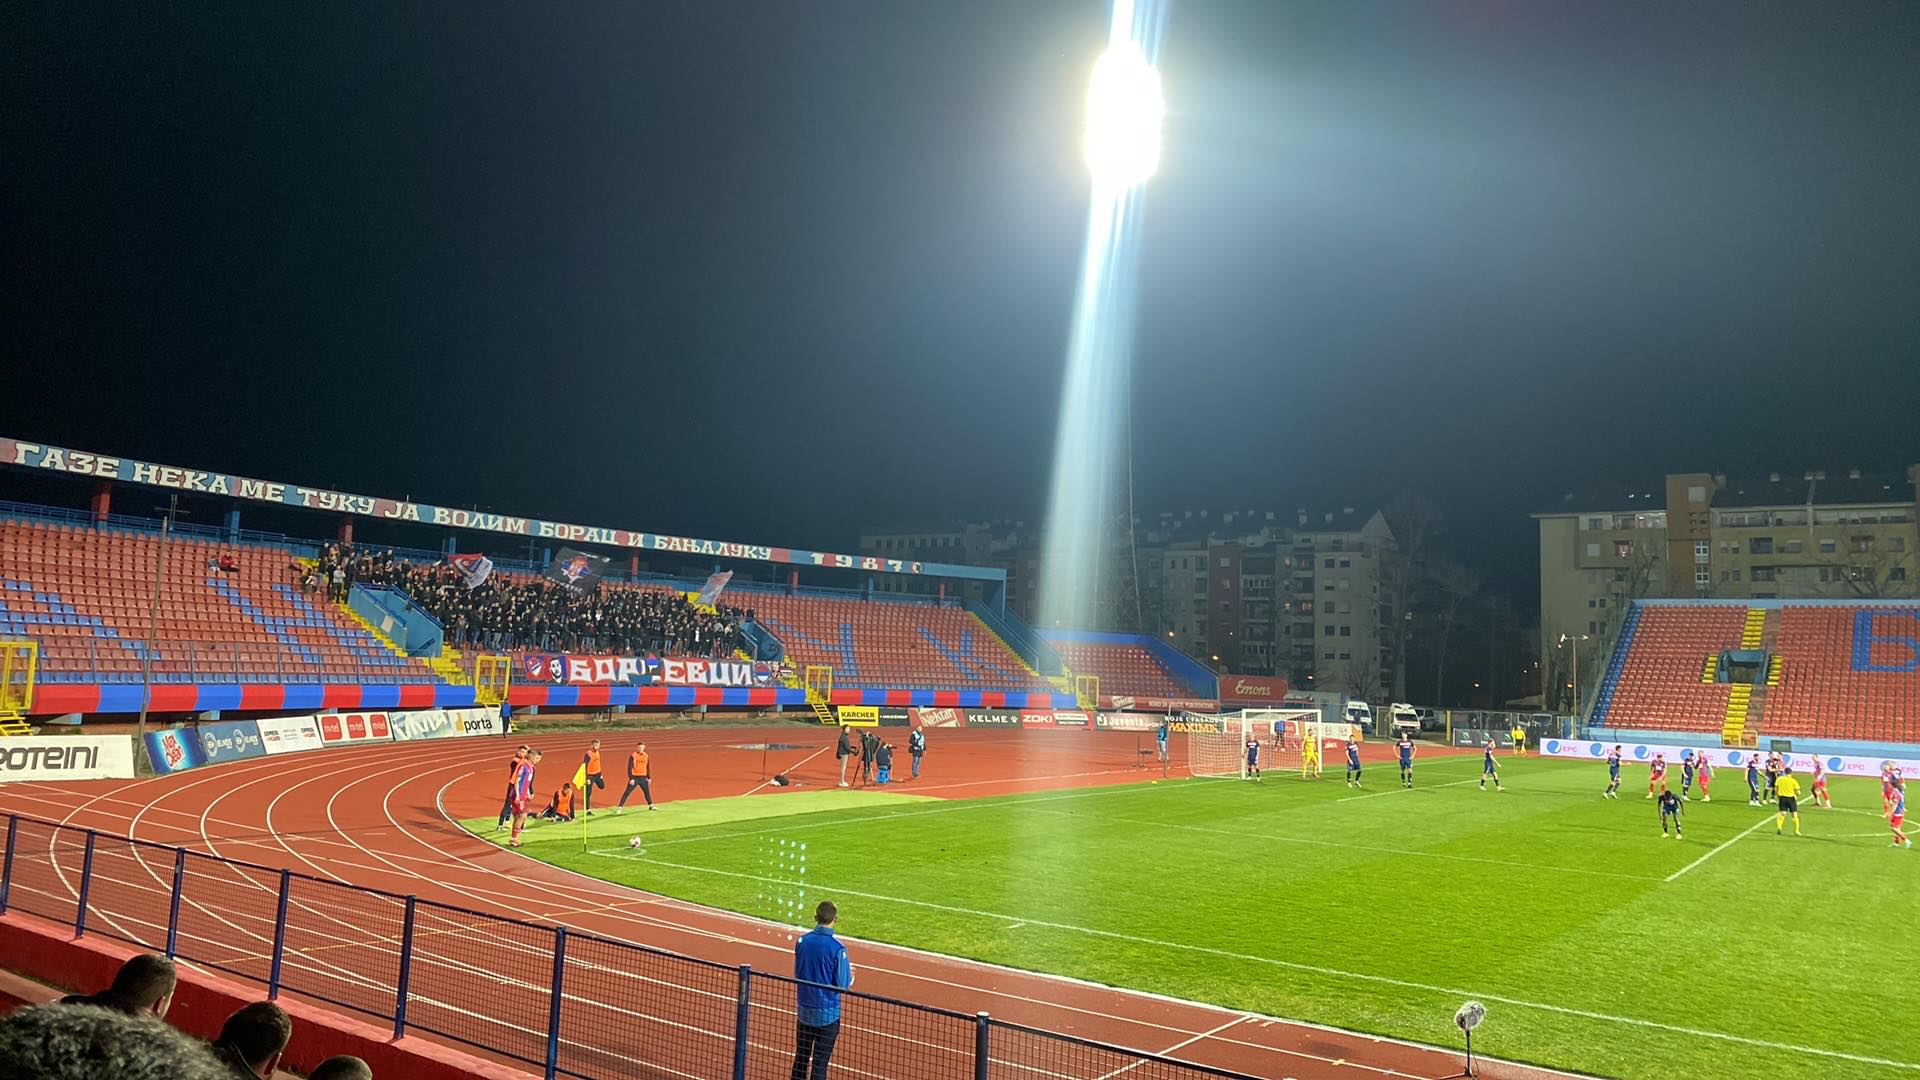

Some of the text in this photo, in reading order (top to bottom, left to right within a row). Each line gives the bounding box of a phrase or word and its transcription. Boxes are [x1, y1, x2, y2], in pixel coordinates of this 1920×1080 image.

[14, 442, 120, 479] ГАЗЕ
[132, 461, 229, 495] НЕКА
[239, 479, 286, 502] МЕ
[297, 488, 376, 515] ТУКУ
[384, 501, 420, 522] ЈА
[433, 507, 526, 535] ВОЛИМ
[539, 521, 618, 545] БОРАЦ
[628, 533, 644, 548] И
[654, 535, 771, 561] БАЊАЛУКУ
[968, 714, 1009, 723] KELME
[1022, 714, 1053, 723] ZOKI
[464, 718, 492, 733] porta
